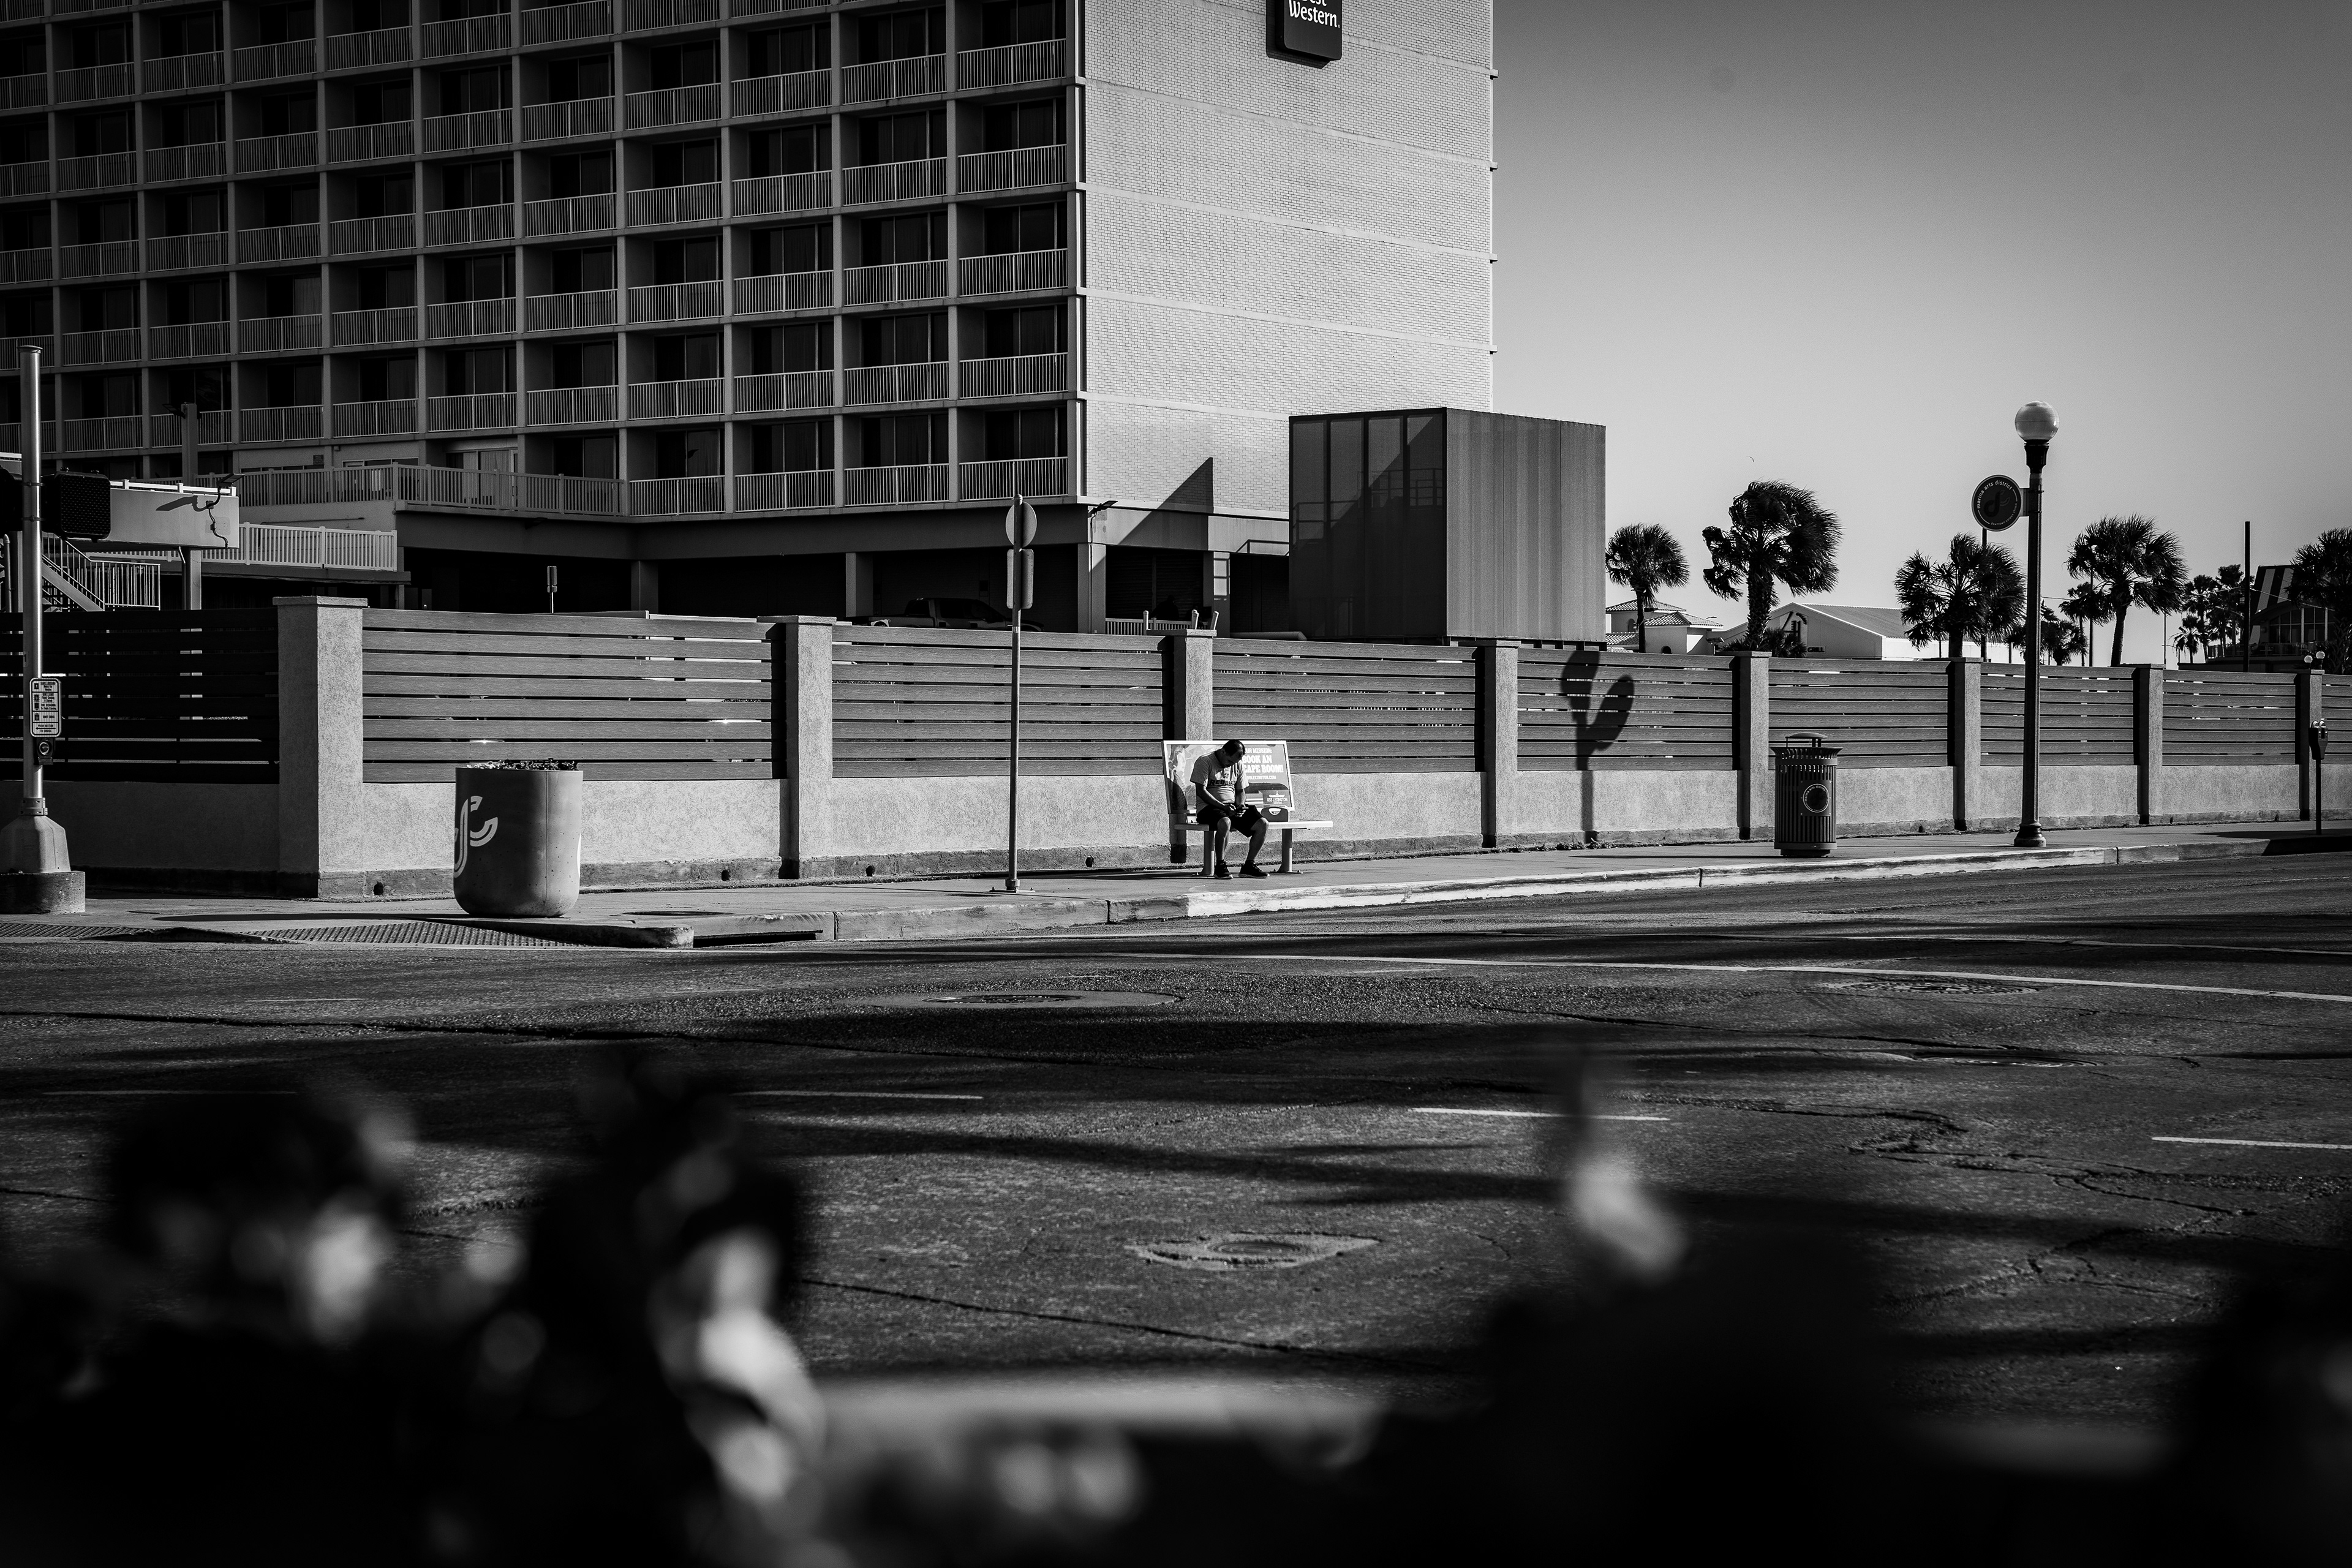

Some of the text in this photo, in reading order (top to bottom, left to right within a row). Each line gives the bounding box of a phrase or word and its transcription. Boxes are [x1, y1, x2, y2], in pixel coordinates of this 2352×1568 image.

[1289, 0, 1338, 28] Western
[1994, 480, 2012, 490] district
[1261, 764, 1284, 773] ROOM!
